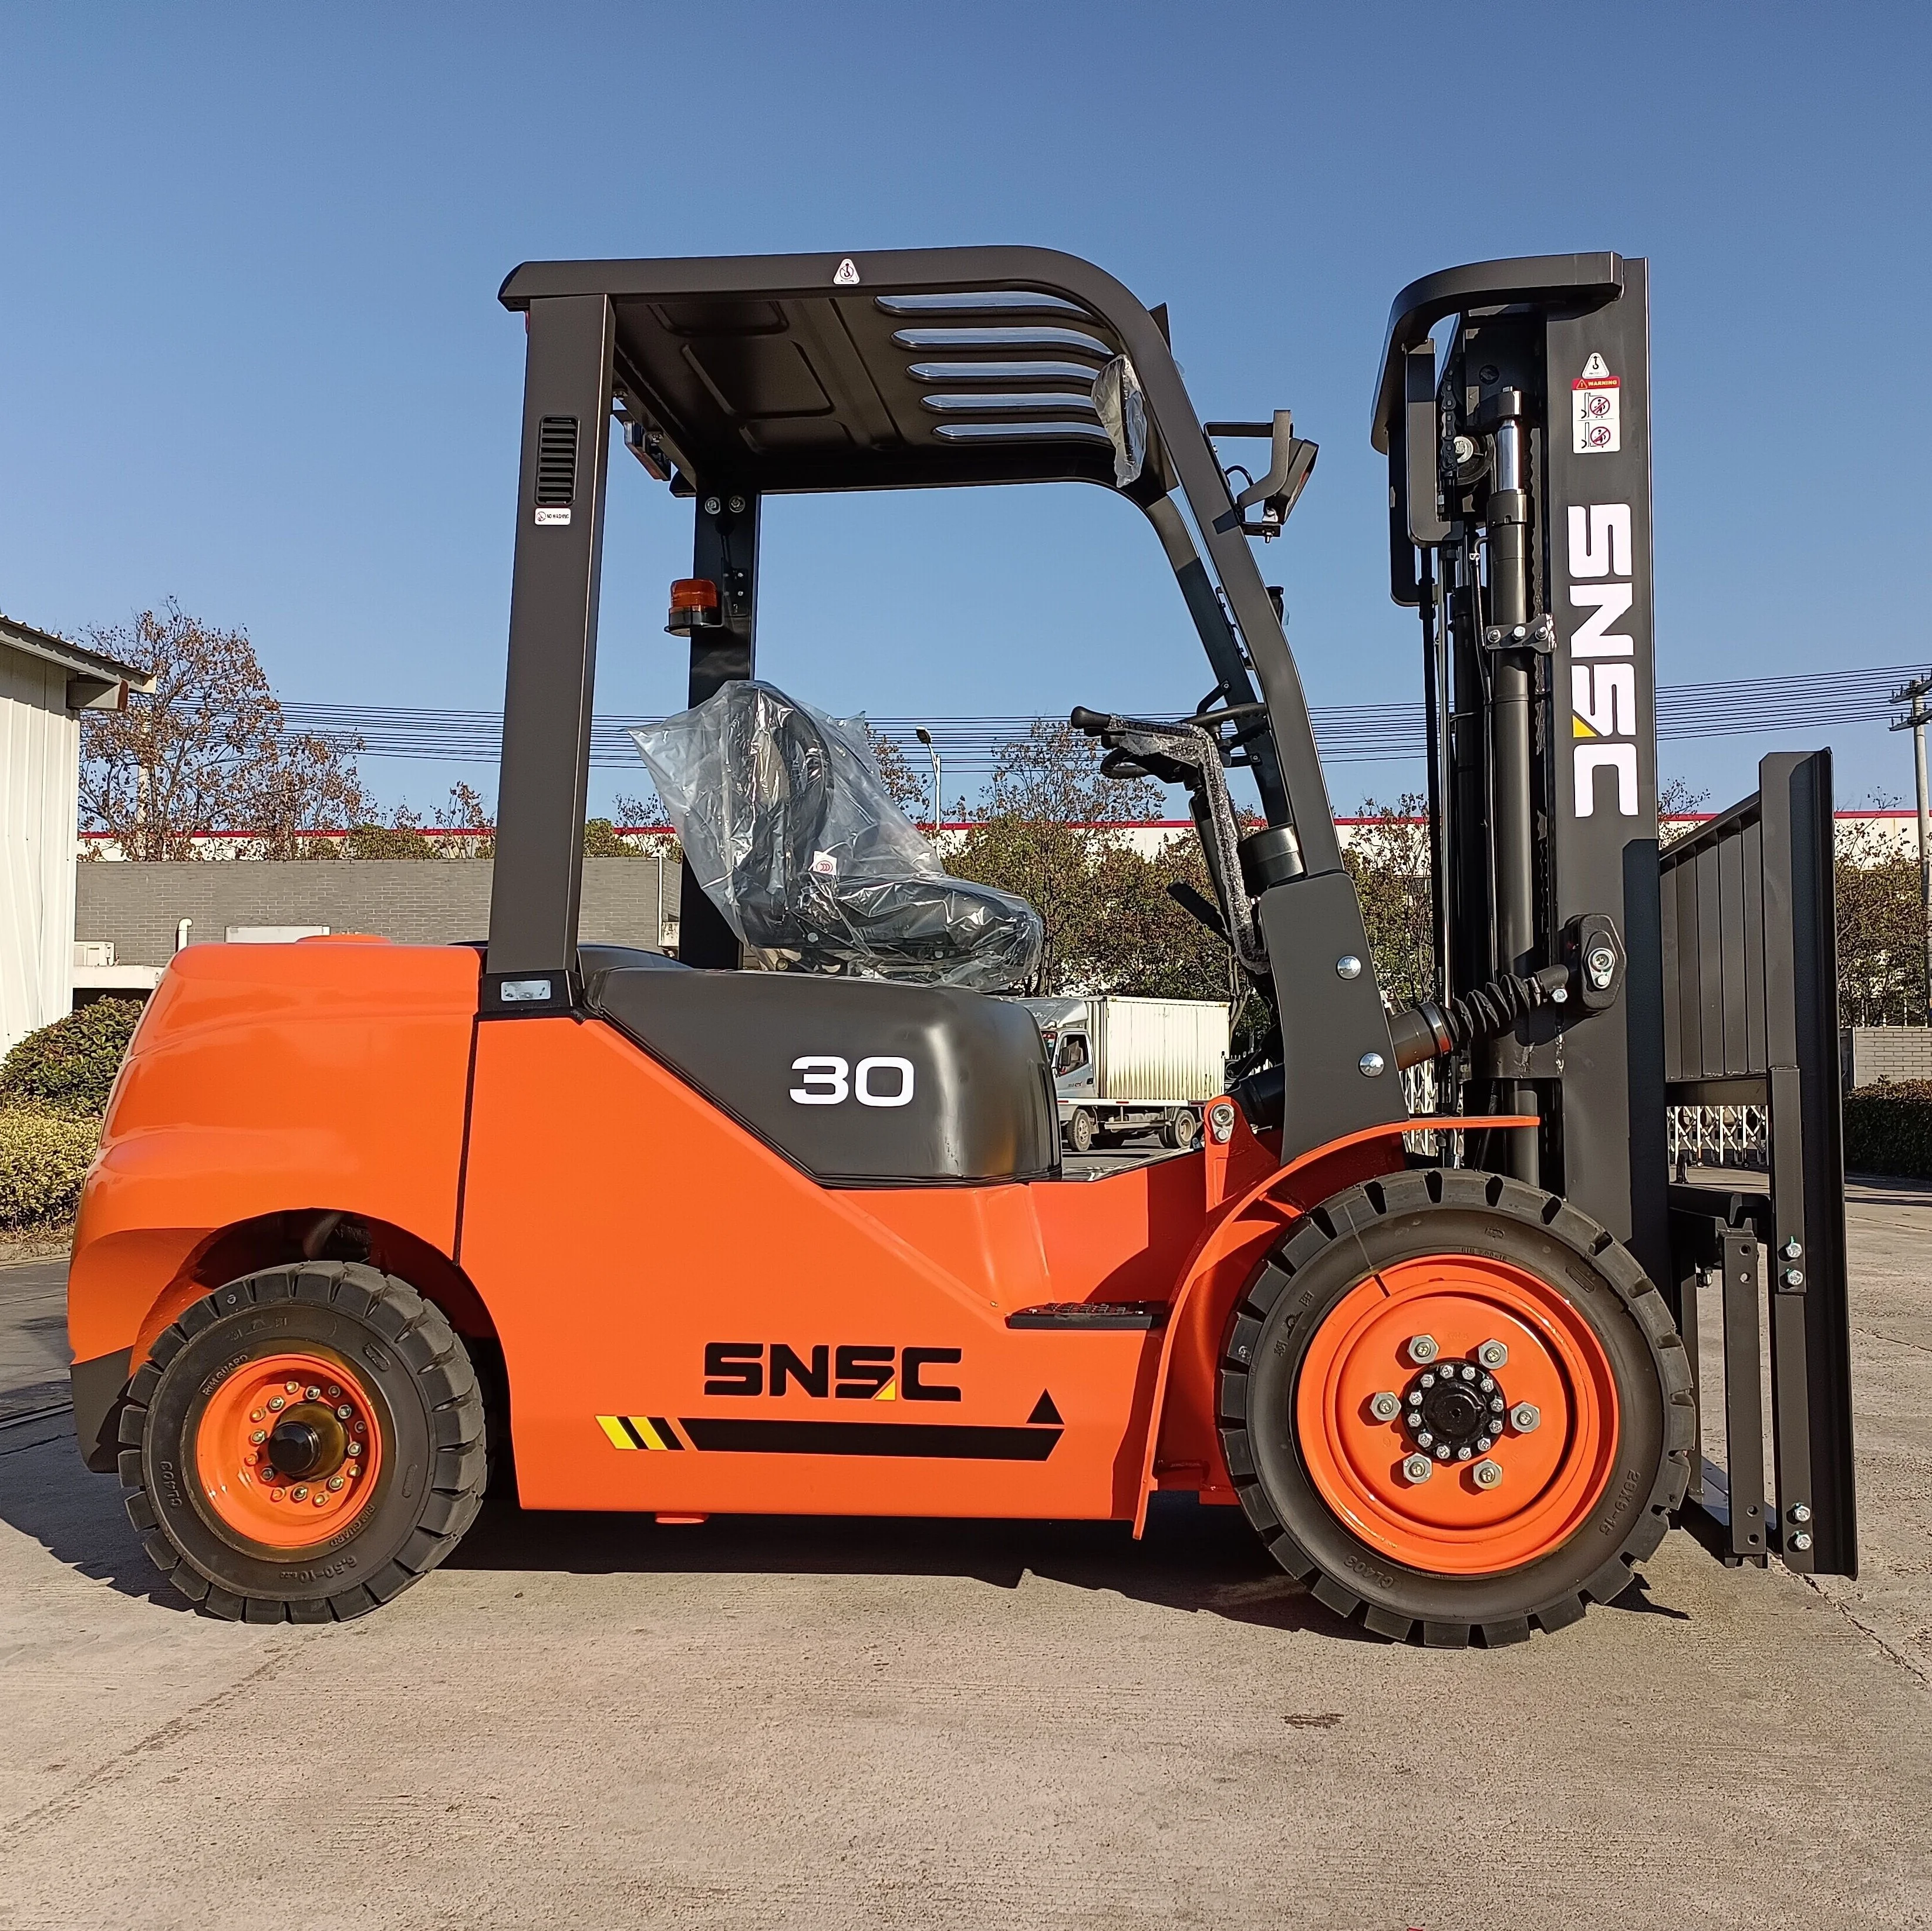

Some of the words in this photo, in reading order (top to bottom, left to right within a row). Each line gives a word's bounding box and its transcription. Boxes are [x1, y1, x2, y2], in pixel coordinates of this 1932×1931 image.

[1568, 503, 1638, 818] SNSC
[790, 1056, 914, 1107] 30
[202, 1378, 220, 1396] RIM
[215, 1355, 248, 1379] GUARD
[704, 1342, 962, 1402] SNSC
[330, 1521, 362, 1547] GUARD
[1343, 1555, 1394, 1589] CL403
